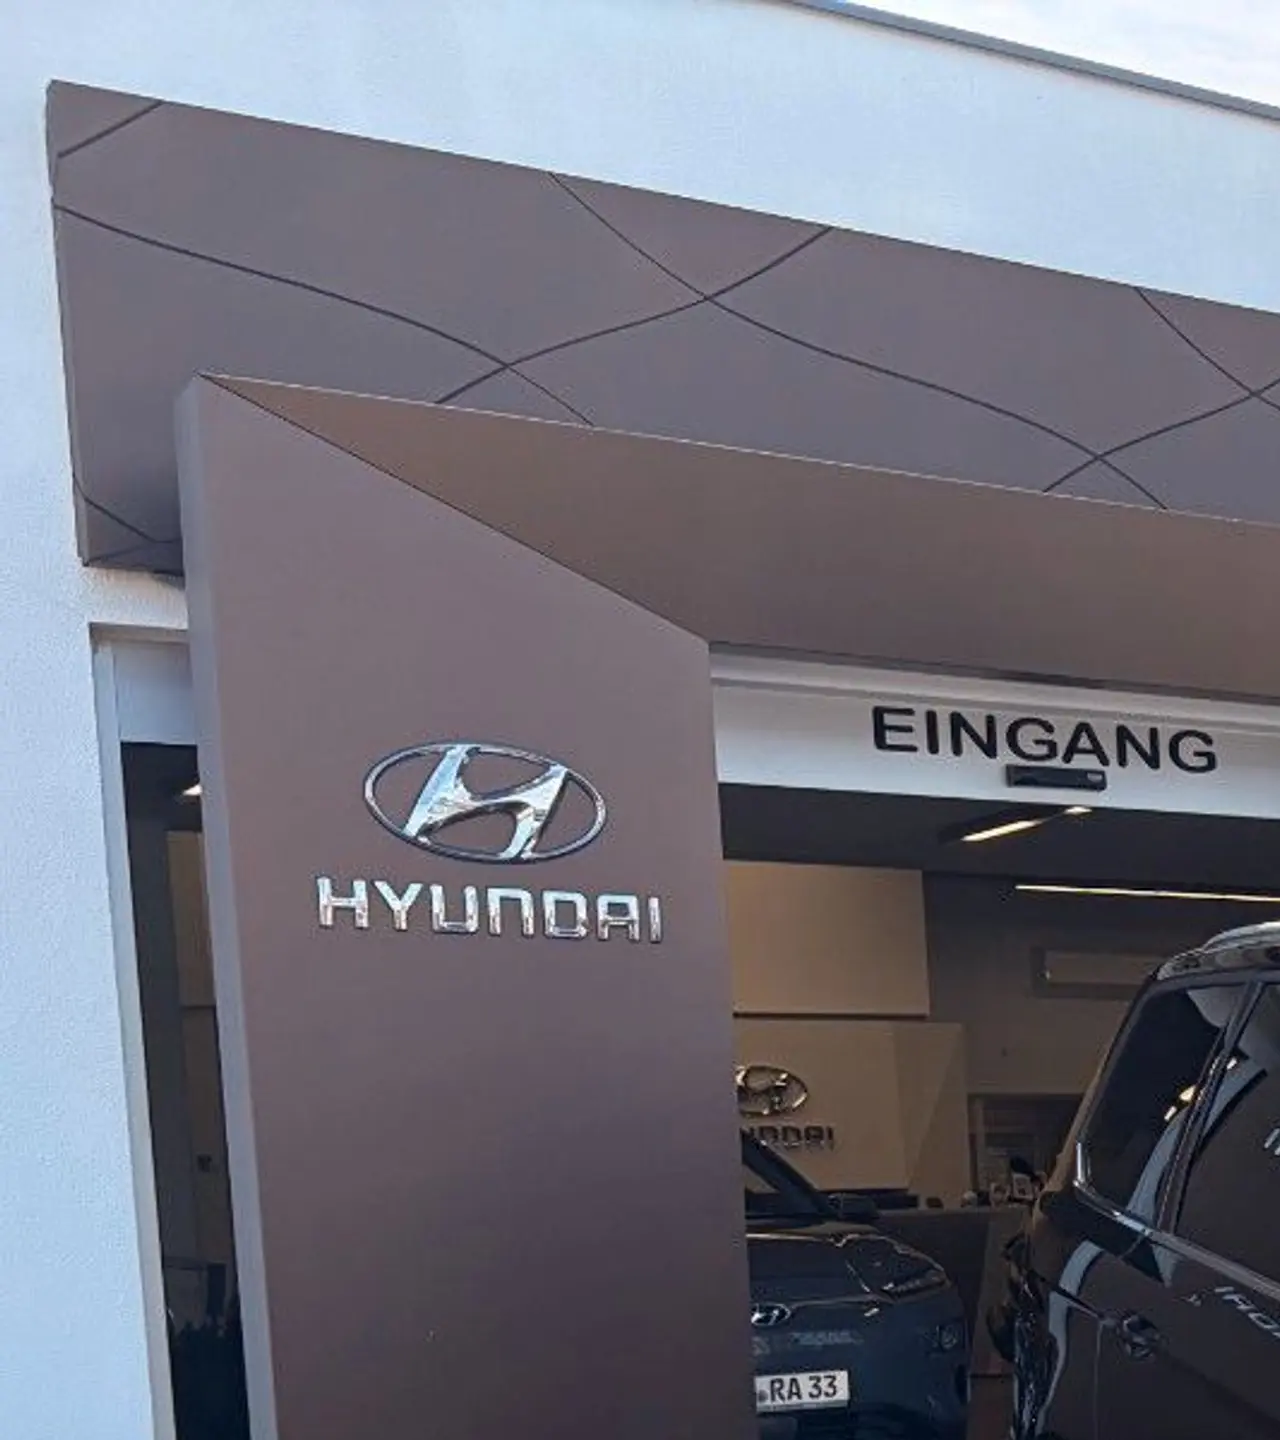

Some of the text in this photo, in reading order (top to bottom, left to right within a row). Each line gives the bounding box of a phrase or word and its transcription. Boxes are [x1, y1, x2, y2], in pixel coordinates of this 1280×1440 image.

[872, 705, 1218, 774] EINGANG
[316, 876, 663, 943] HYUNDAI
[769, 1375, 838, 1402] RA 33
